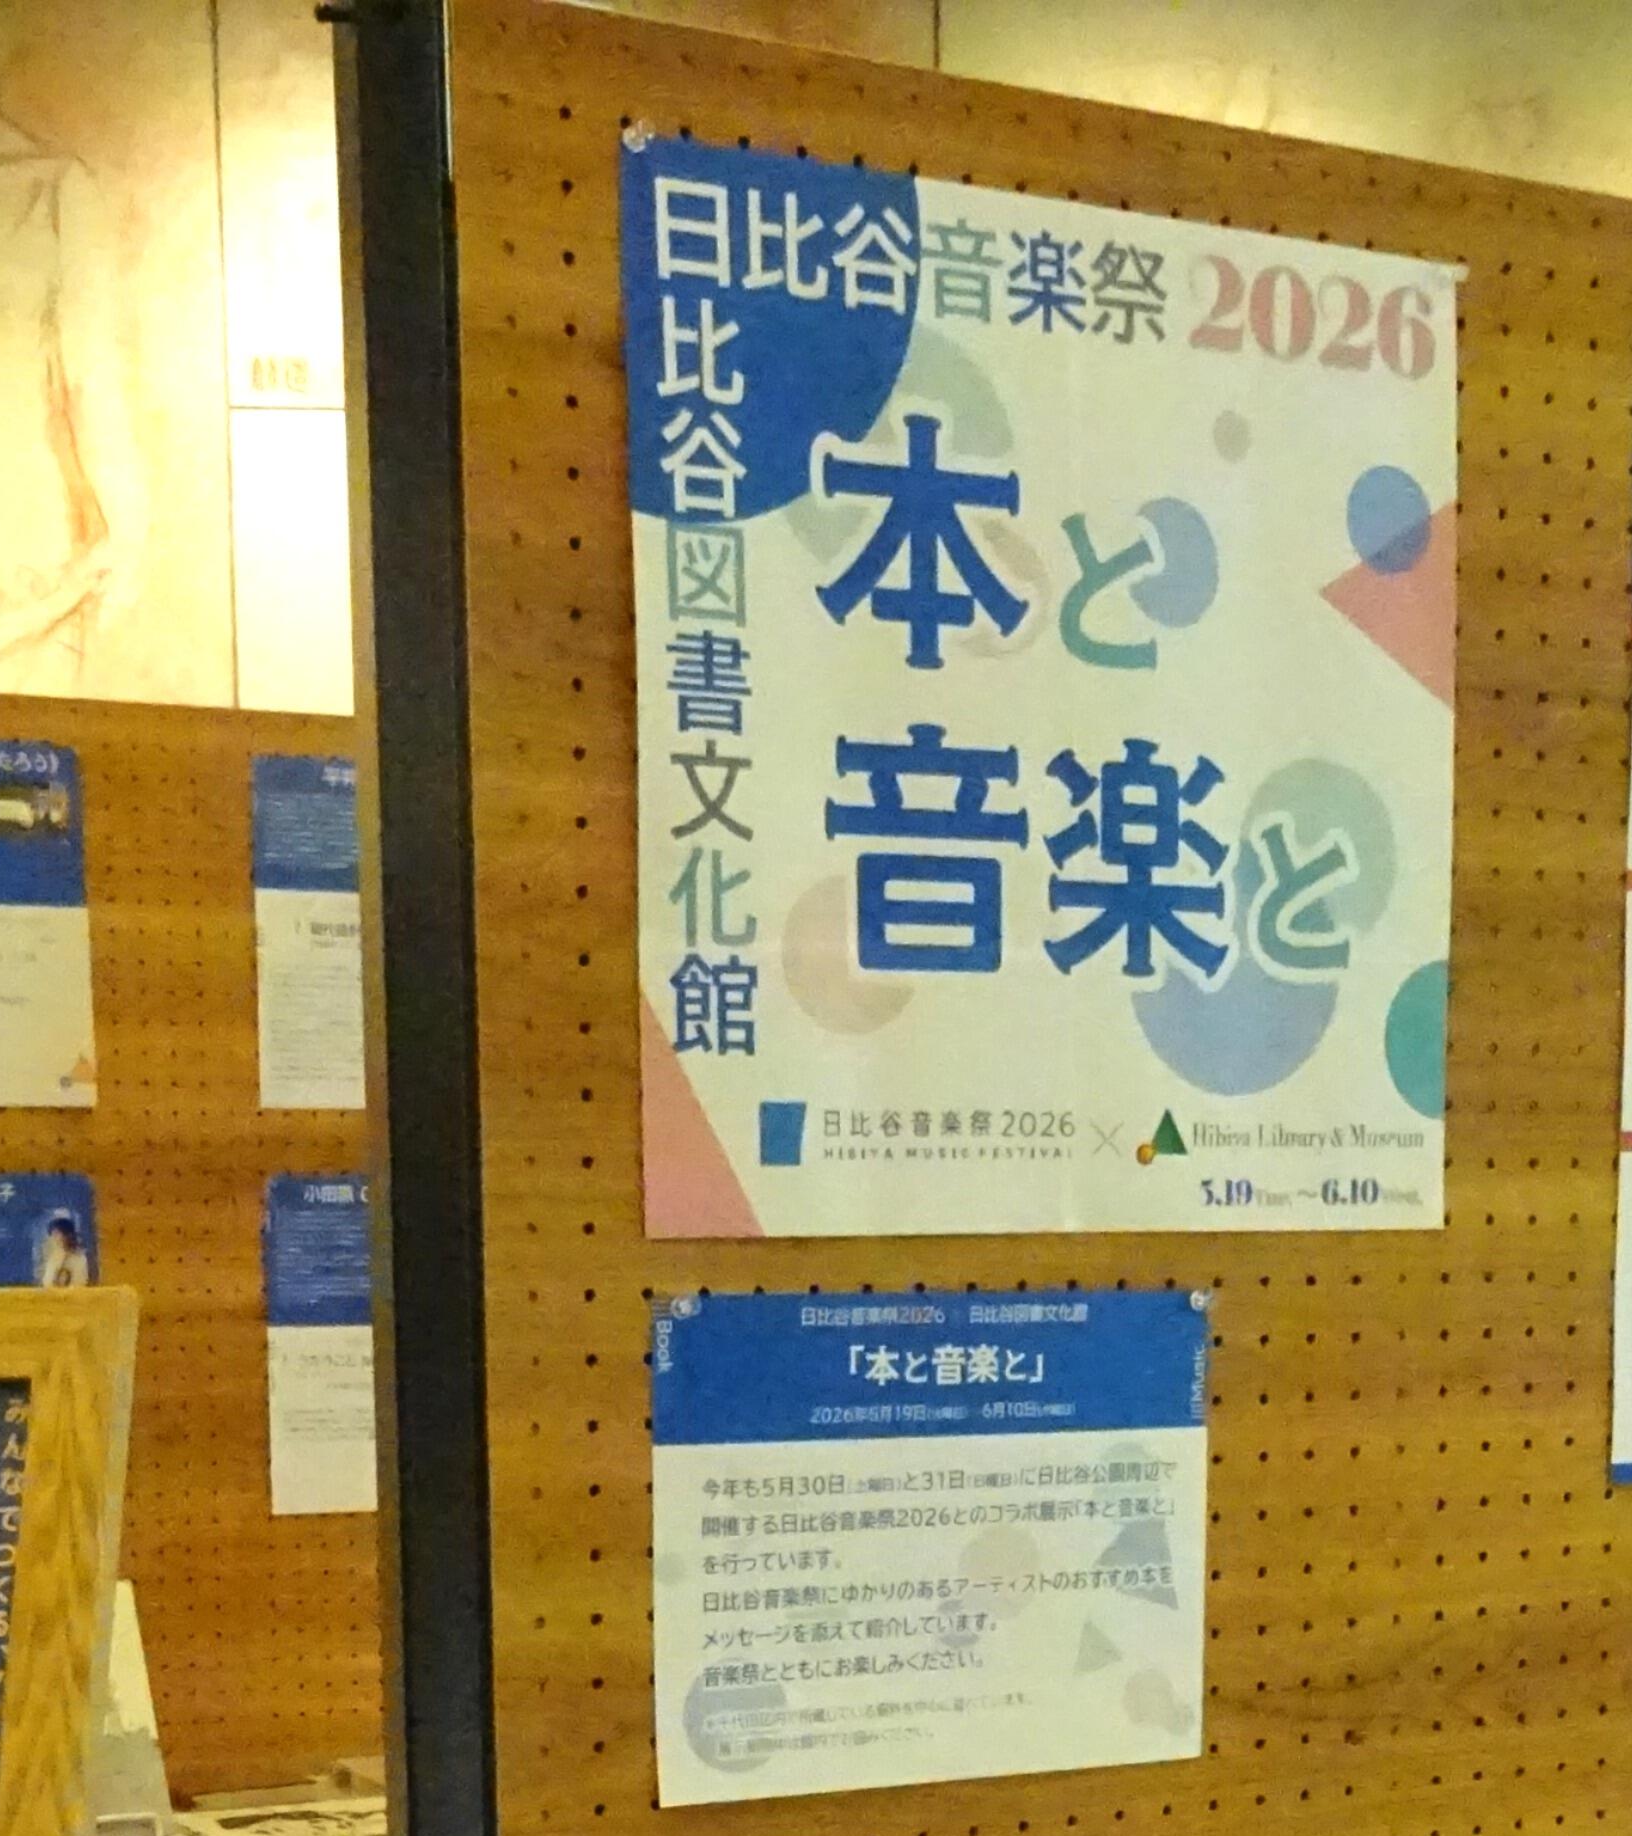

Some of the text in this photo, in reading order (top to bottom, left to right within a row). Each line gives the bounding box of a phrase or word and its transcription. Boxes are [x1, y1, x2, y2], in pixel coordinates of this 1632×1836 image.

[653, 174, 1437, 379] 日比谷音楽祭 2026
[812, 413, 1159, 671] 本と
[824, 722, 1360, 982] 音楽と
[1000, 1110, 1077, 1139] 2026
[848, 1344, 1044, 1387] 「本と音楽と」
